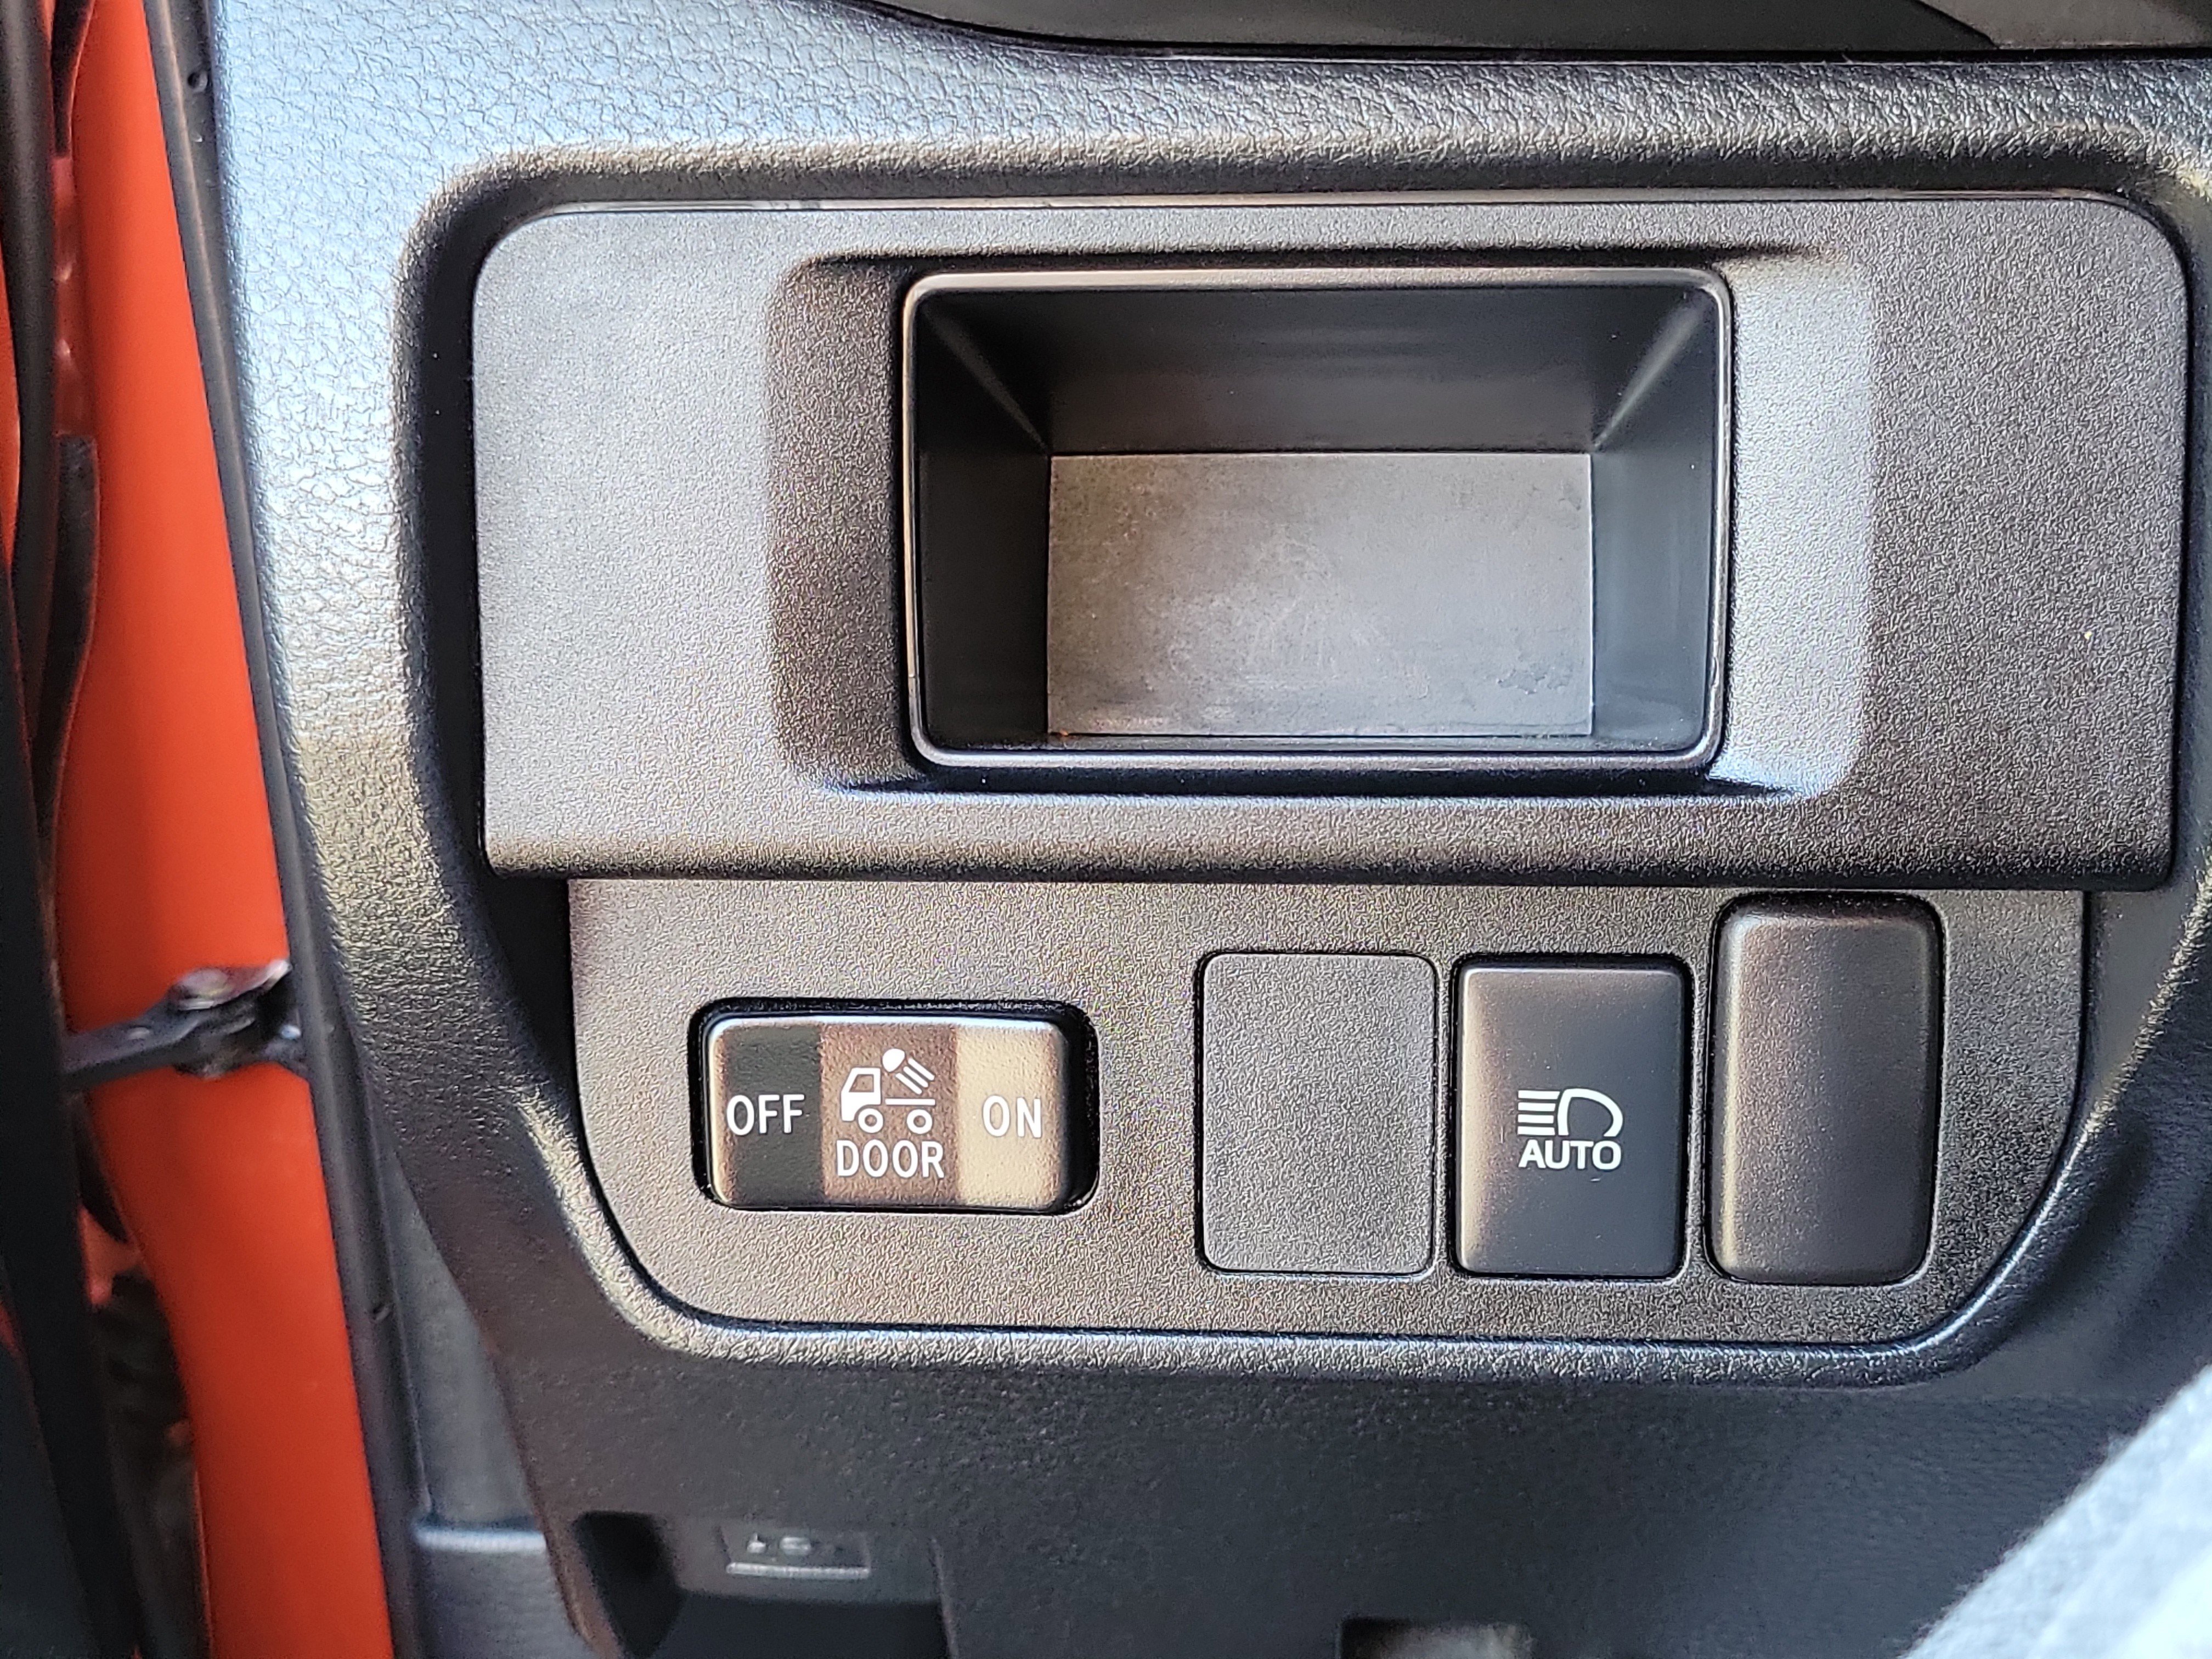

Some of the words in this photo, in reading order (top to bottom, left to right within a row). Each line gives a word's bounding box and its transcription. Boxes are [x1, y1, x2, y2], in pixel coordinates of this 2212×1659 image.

[726, 1094, 805, 1136] OFF
[982, 1096, 1043, 1138] ON
[836, 1139, 945, 1179] DOOR
[1517, 1139, 1622, 1170] AUTO
